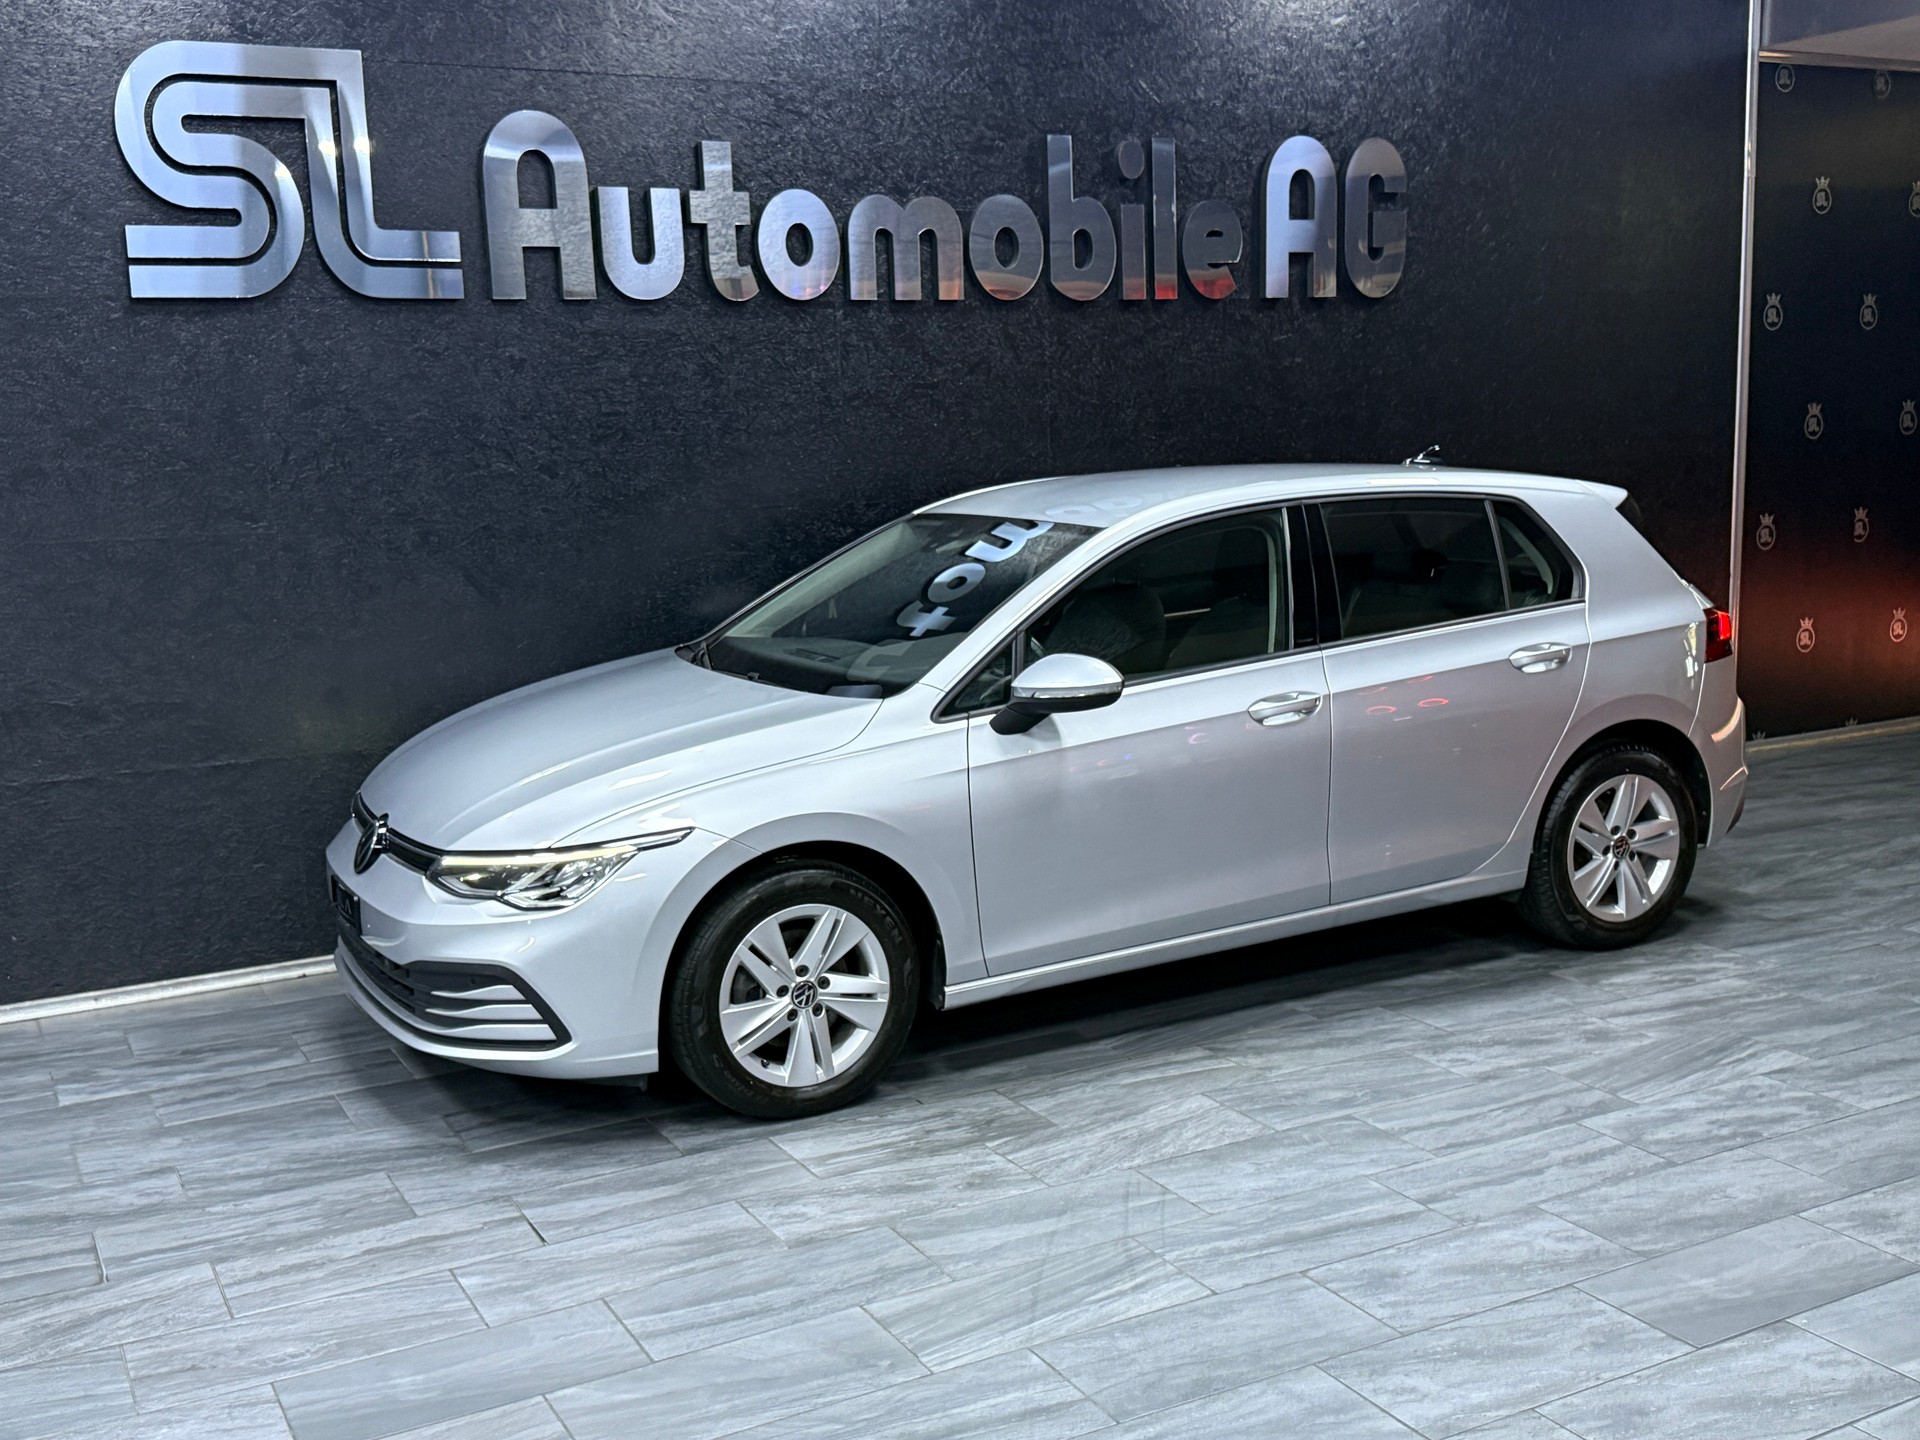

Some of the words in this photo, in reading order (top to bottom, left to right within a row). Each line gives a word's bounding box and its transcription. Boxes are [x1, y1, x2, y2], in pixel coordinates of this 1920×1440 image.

[114, 40, 464, 299] SL
[482, 110, 1243, 301] Automobile
[1263, 135, 1407, 299] AG
